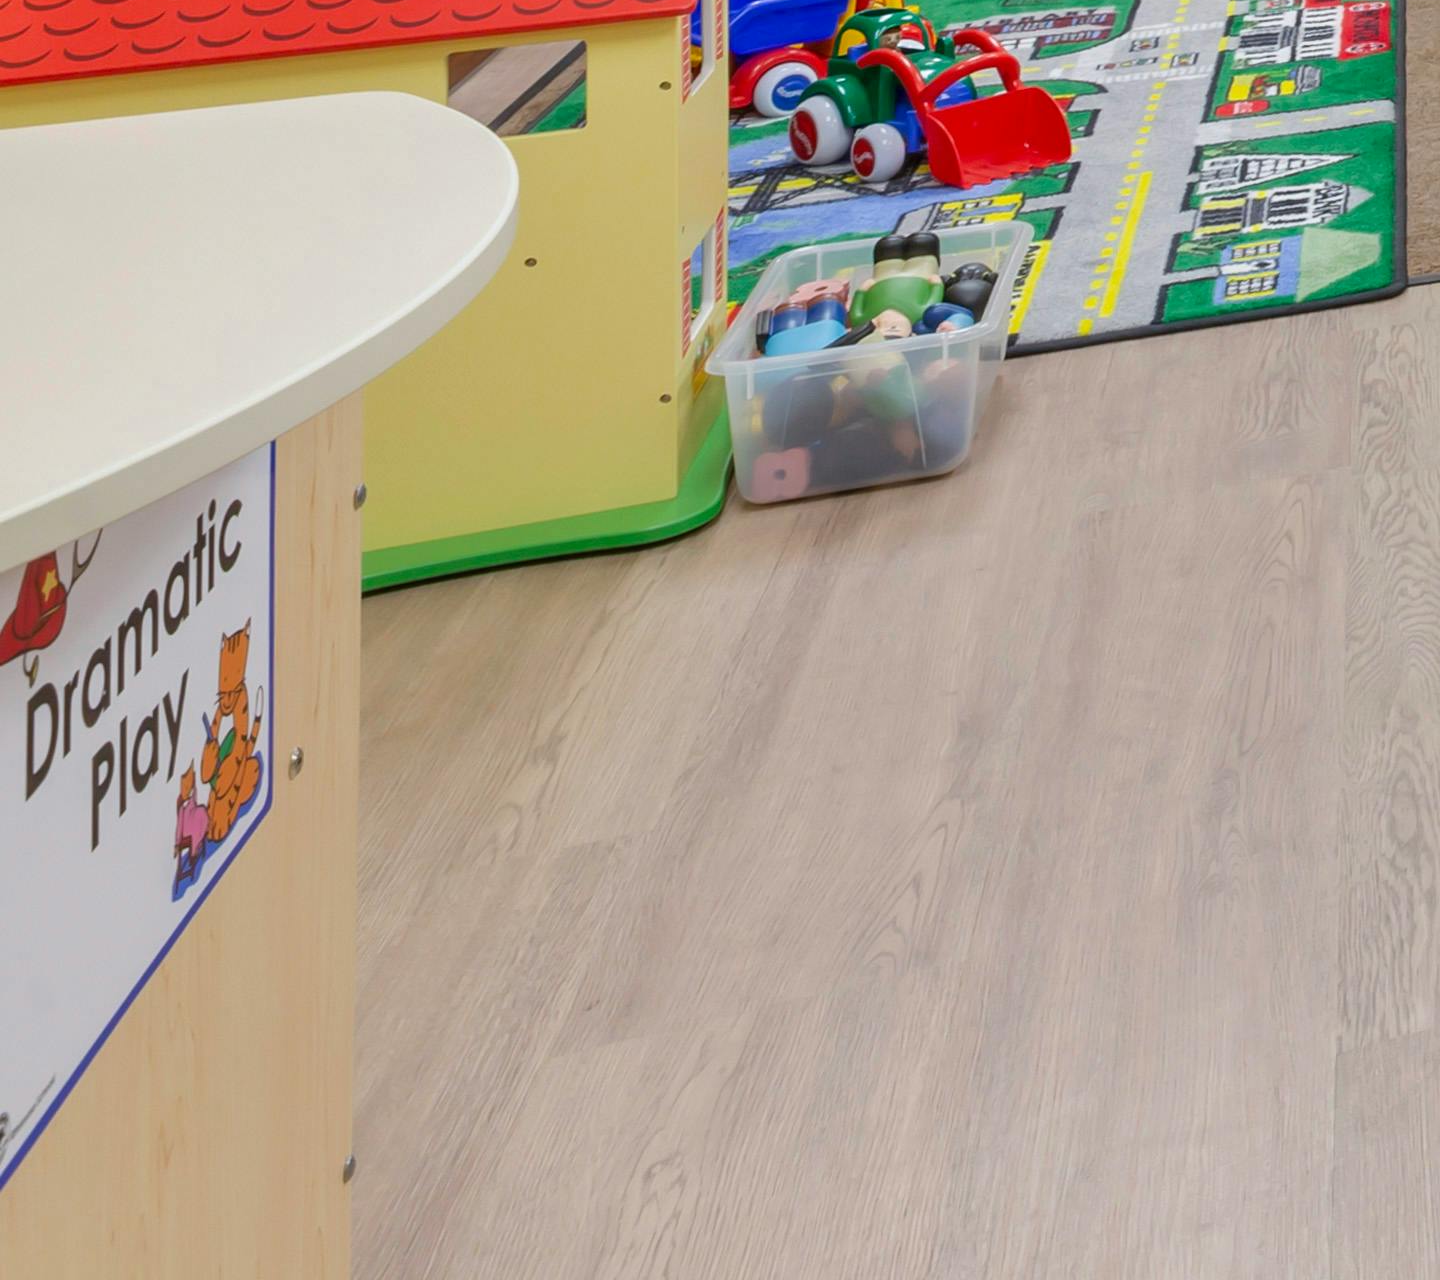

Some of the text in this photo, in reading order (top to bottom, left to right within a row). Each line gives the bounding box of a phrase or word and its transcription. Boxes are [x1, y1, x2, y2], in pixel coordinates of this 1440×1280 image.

[1312, 184, 1343, 218] BANK
[25, 498, 243, 802] Dramatic
[91, 667, 190, 853] Play
